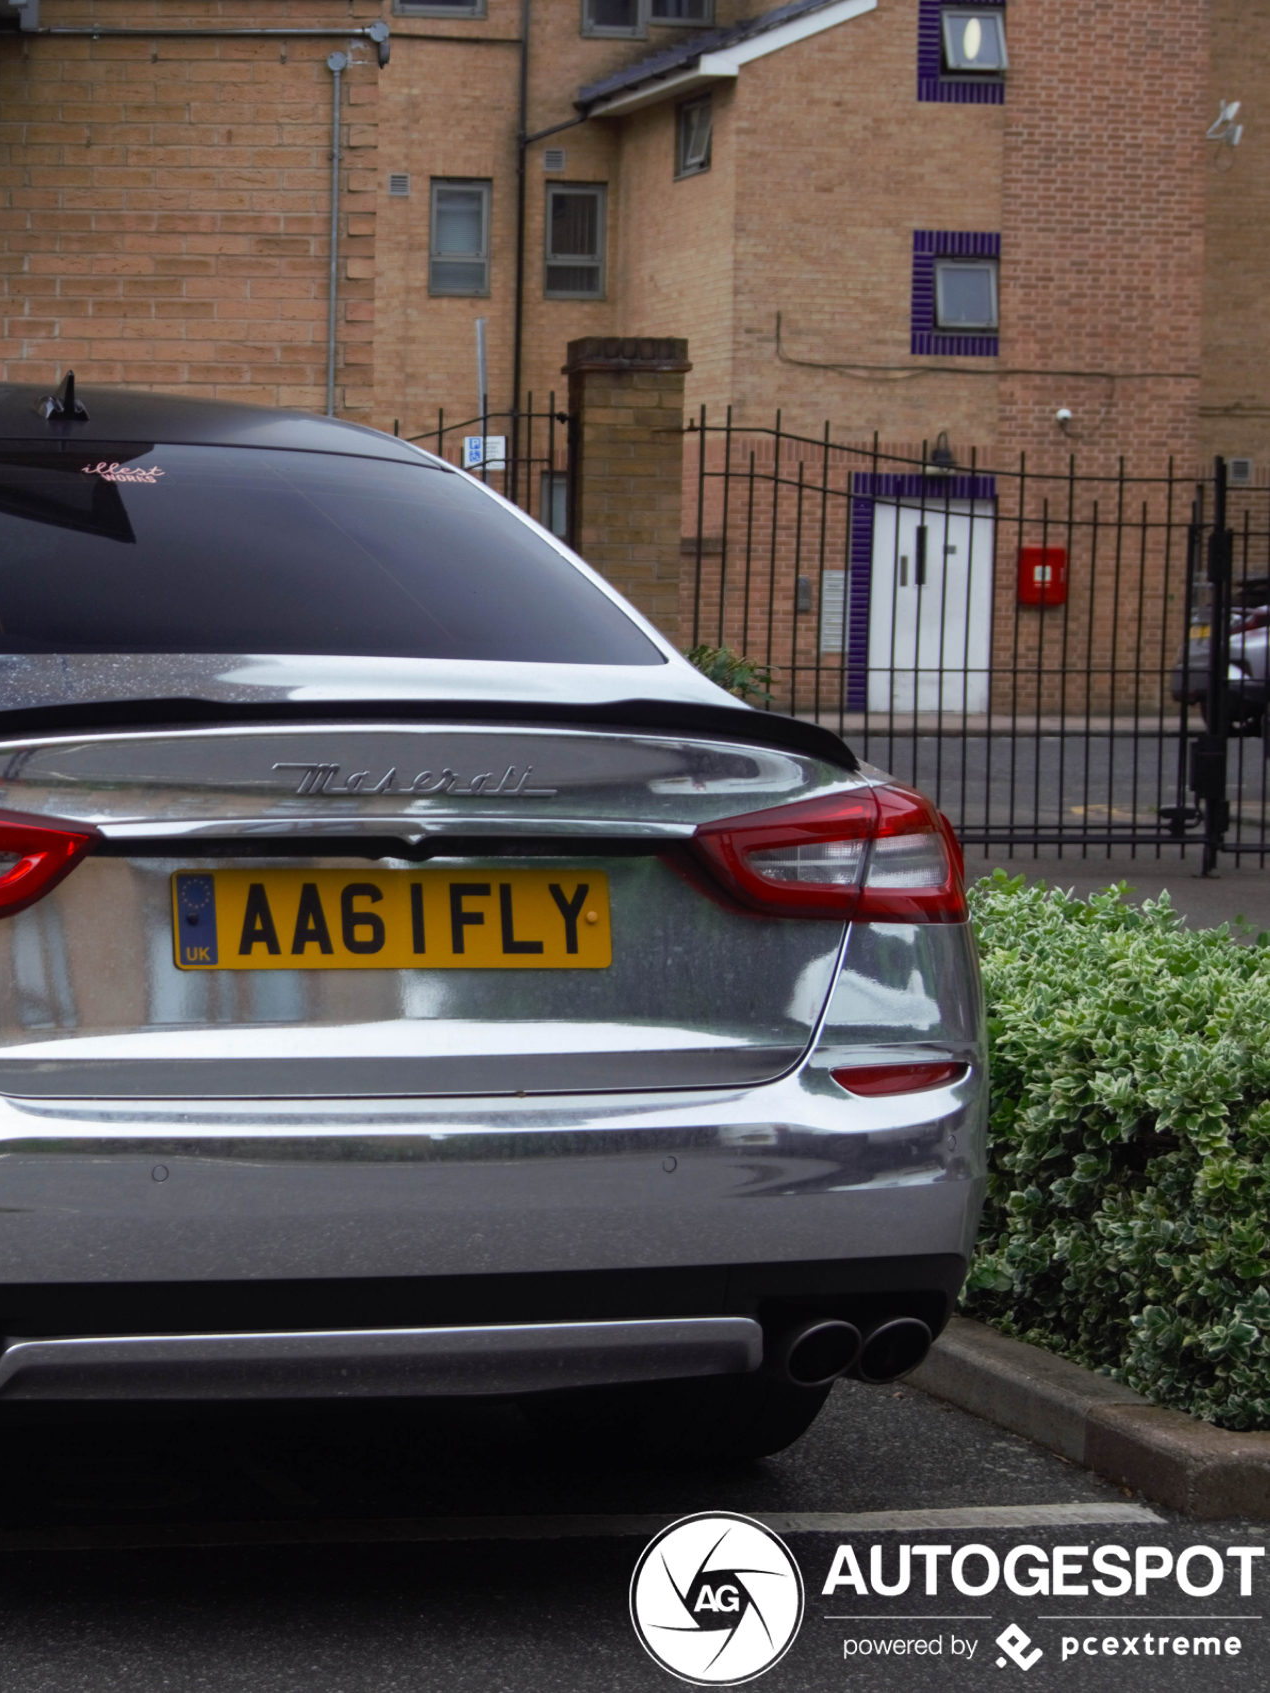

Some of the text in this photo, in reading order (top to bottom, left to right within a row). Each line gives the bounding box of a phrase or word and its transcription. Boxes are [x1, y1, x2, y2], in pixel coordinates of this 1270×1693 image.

[81, 461, 165, 476] illest
[101, 474, 157, 483] WORKS
[271, 762, 557, 796] Maserati
[186, 947, 211, 962] UK
